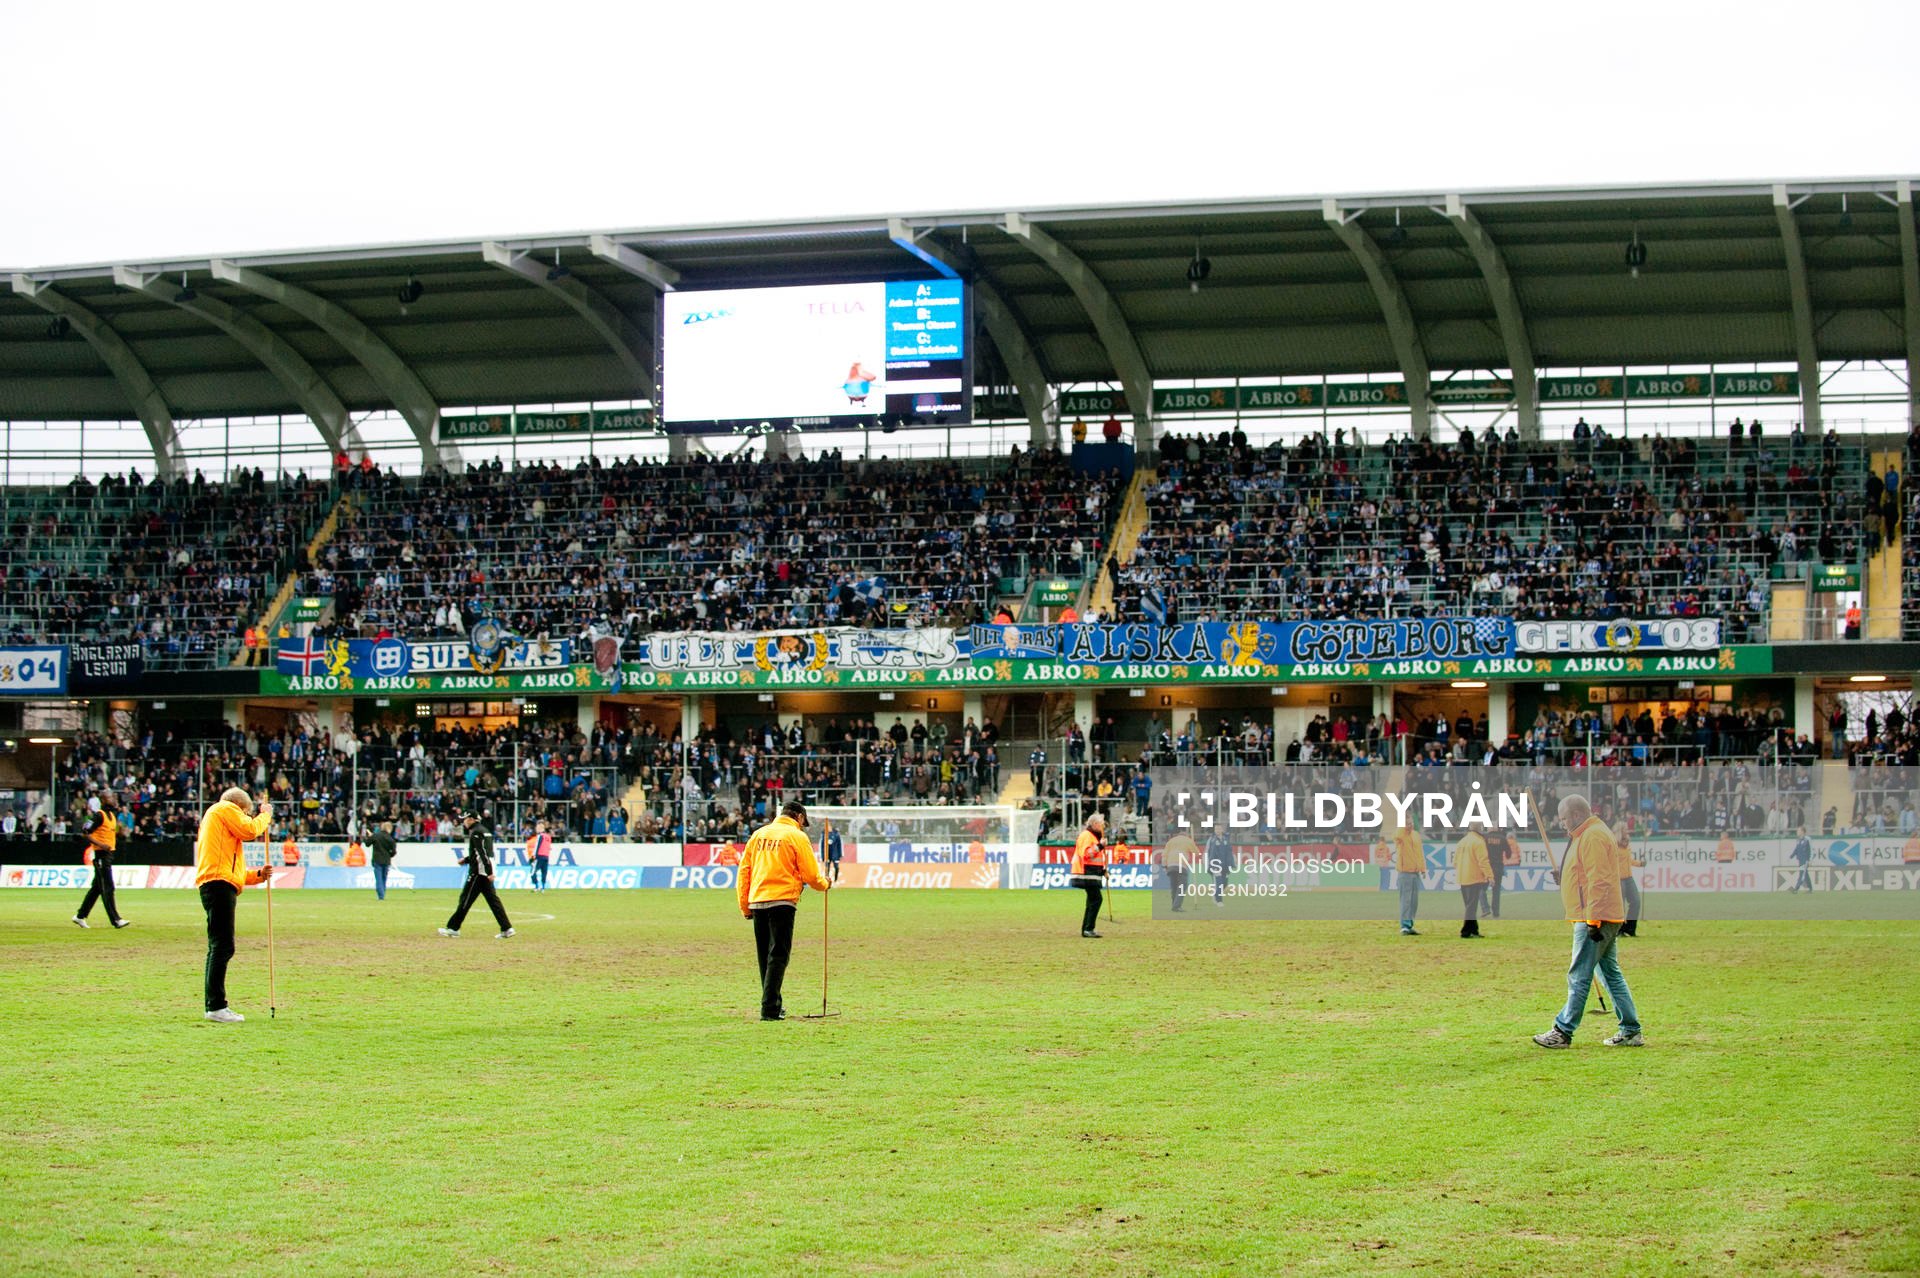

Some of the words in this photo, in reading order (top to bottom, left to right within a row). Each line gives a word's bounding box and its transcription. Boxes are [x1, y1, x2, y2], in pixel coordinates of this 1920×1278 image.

[1067, 623, 1217, 664] ÄLSKA
[1515, 620, 1598, 653] GFK
[411, 645, 471, 671] SUP
[864, 865, 953, 888] Renova
